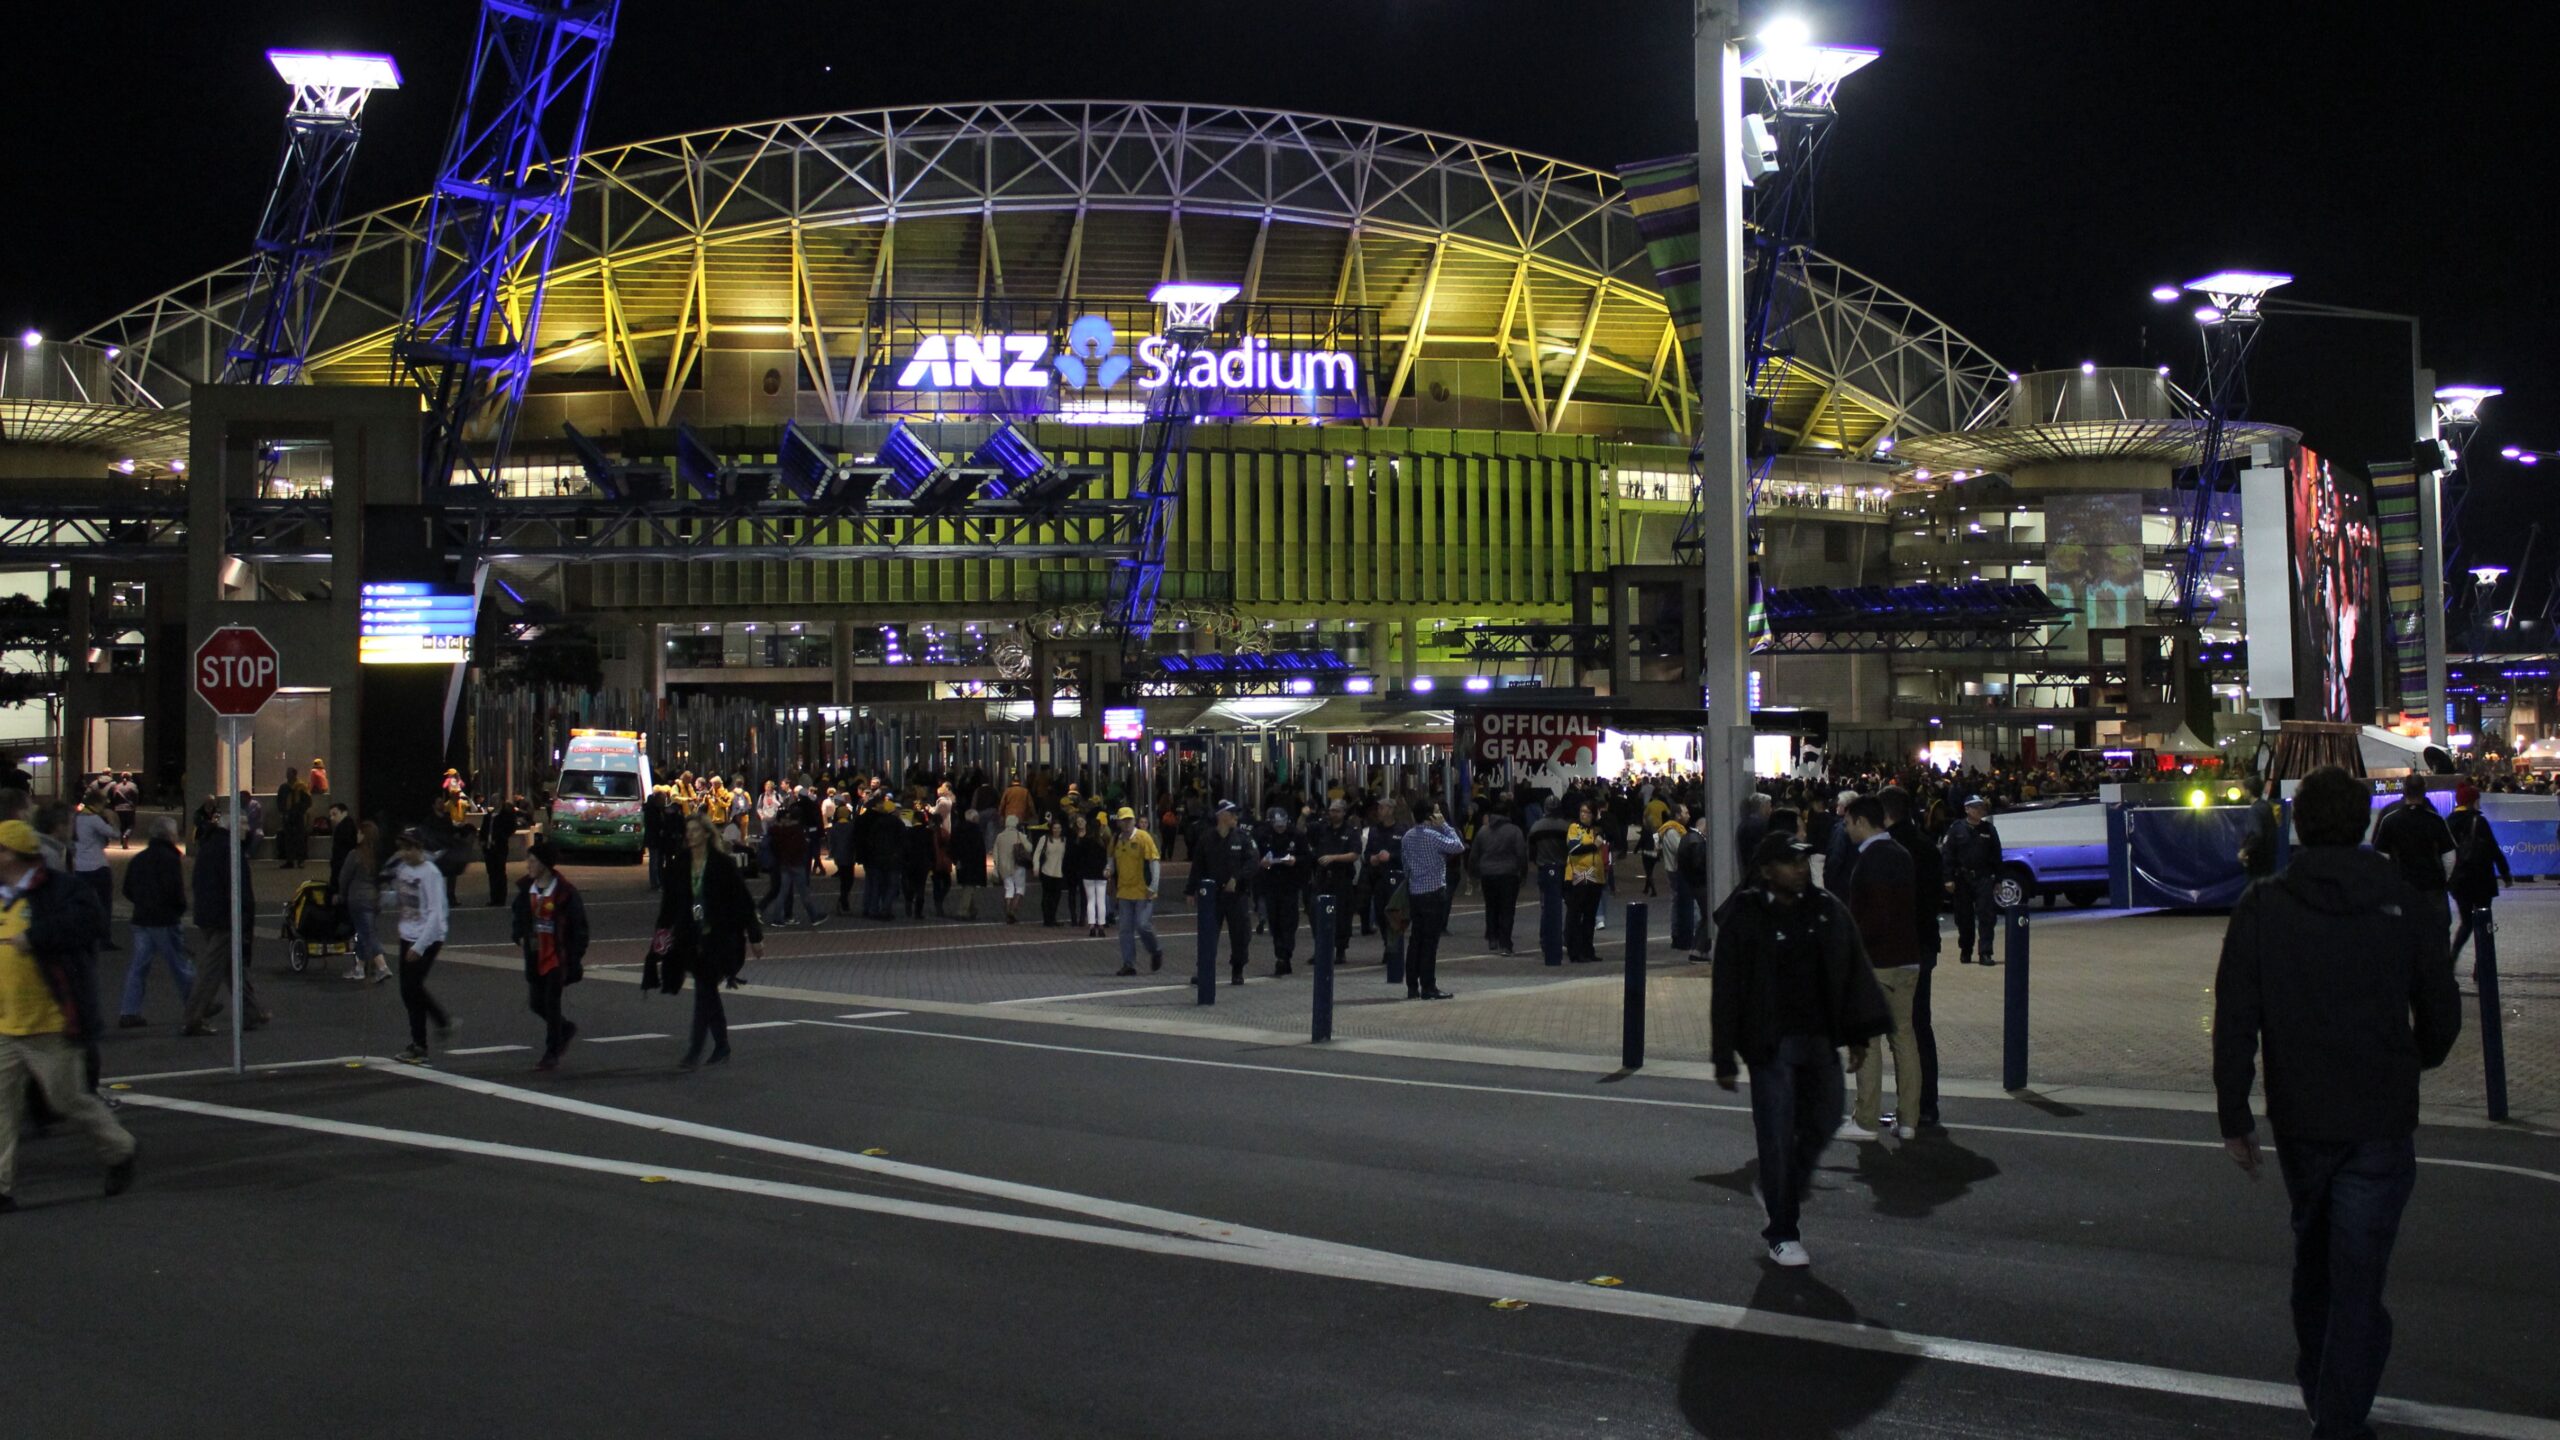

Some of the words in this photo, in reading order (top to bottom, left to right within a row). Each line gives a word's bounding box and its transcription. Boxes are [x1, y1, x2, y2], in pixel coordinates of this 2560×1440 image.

[897, 333, 1049, 388] ANZ
[1137, 335, 1355, 390] Stadium
[202, 655, 274, 688] STOP
[1482, 714, 1596, 736] OFFICIAL
[1347, 735, 1380, 745] Tickets
[1482, 738, 1549, 760] GEAR
